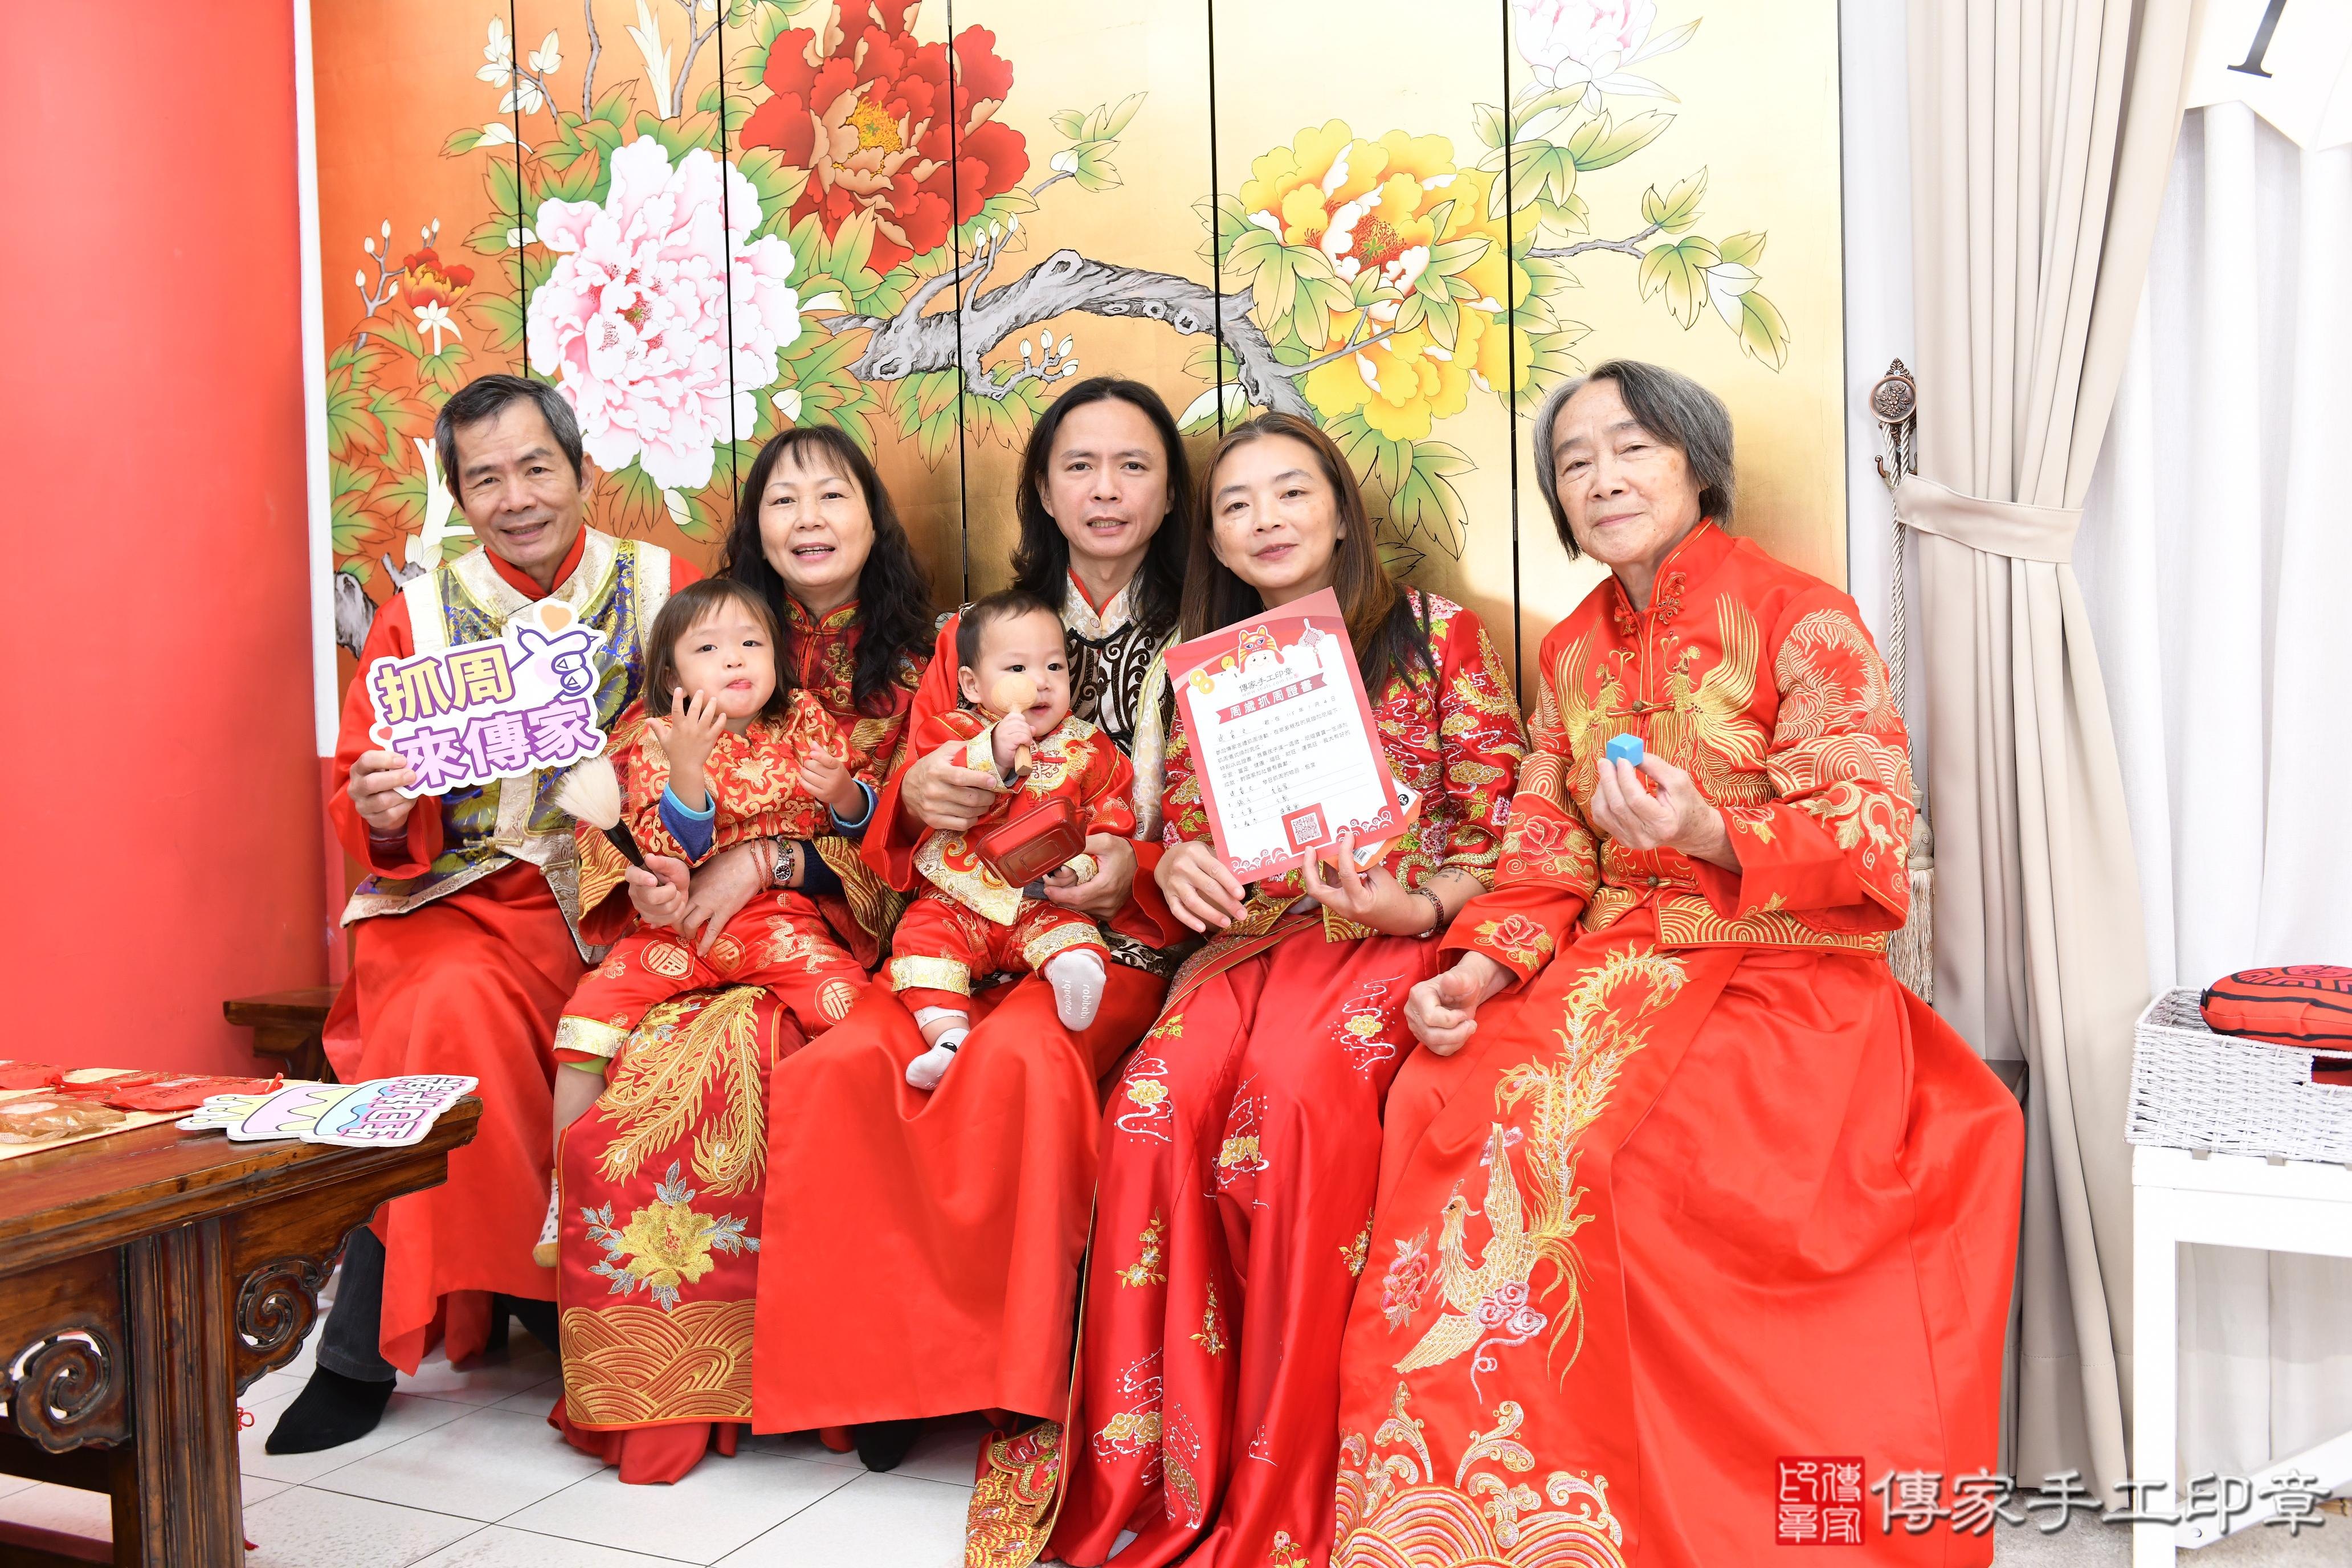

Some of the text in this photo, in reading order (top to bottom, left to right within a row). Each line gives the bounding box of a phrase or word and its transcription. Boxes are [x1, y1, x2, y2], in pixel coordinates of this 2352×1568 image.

[376, 645, 514, 724] 抓周
[1230, 679, 1313, 719] 周歲抓周證書
[1239, 667, 1293, 693] 傳家手工印章
[394, 699, 598, 789] 來傳家
[340, 1076, 466, 1139] 生日快樂
